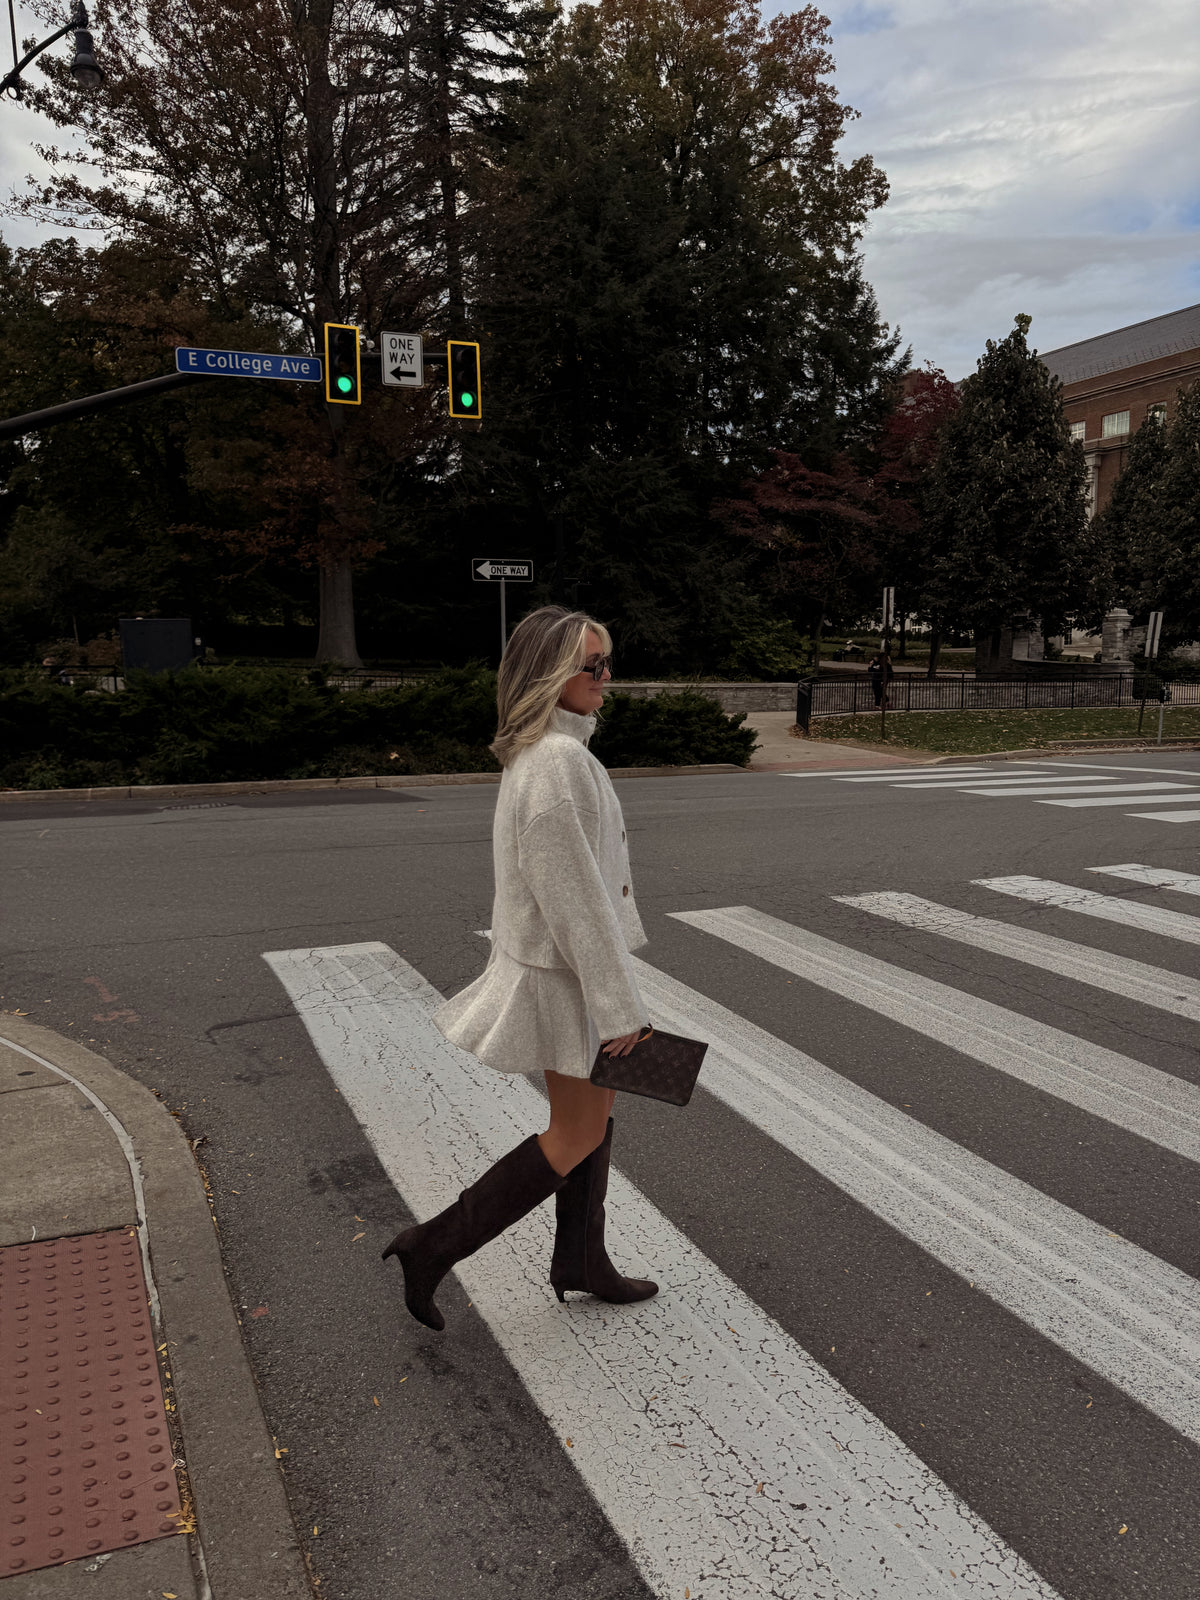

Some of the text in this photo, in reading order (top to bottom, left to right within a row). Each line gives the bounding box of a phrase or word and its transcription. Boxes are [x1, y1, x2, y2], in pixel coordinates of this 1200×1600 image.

[389, 337, 414, 351] ONE
[188, 352, 310, 374] E College Ave
[389, 351, 415, 365] WAY
[490, 566, 526, 575] ONE WAY
